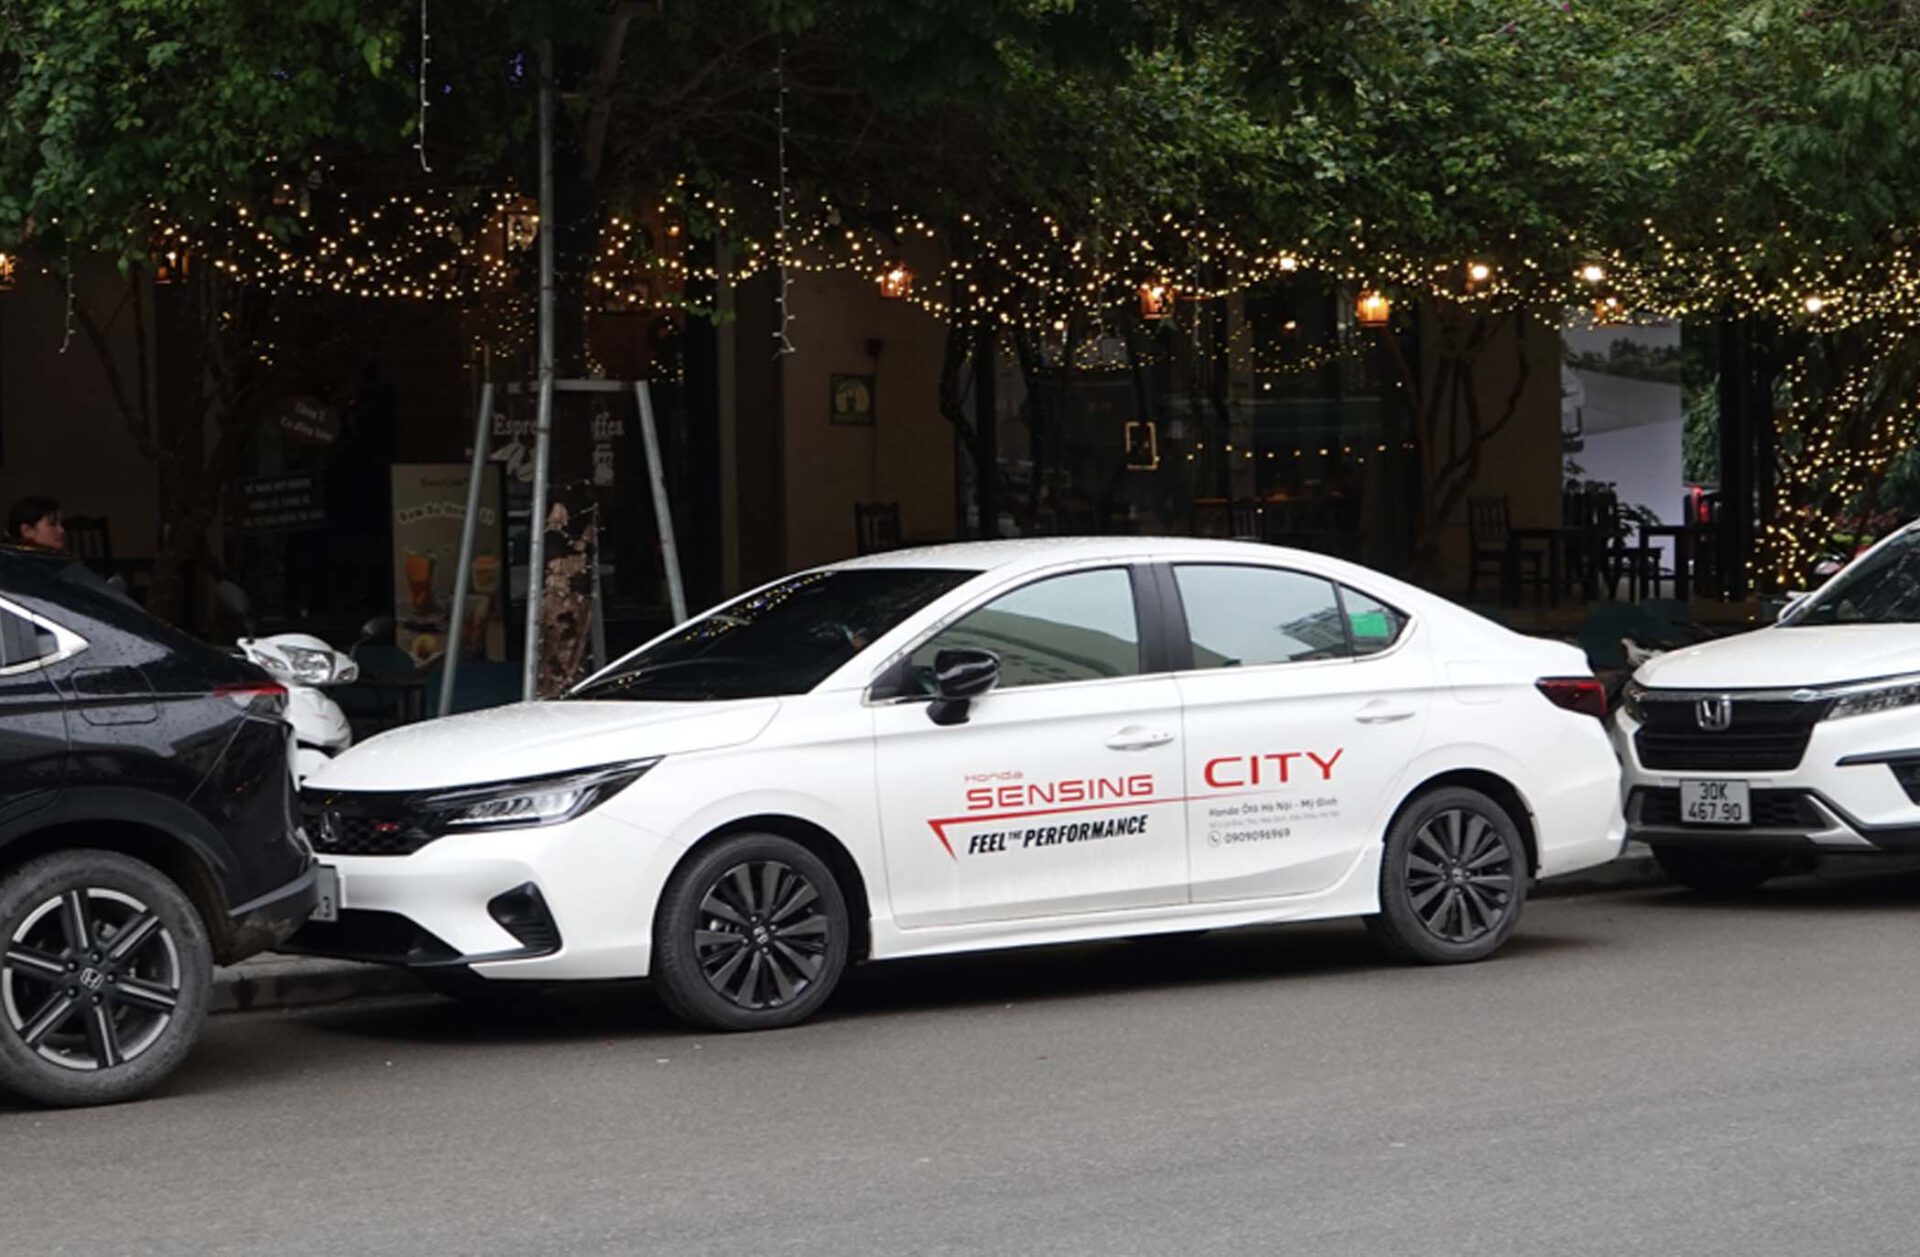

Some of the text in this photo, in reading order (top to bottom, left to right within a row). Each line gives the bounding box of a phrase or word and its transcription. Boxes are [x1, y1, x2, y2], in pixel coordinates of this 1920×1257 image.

[964, 770, 1024, 783] Honda
[1204, 748, 1345, 788] CITY
[966, 774, 1154, 811] SENSING
[1699, 782, 1728, 800] 30K
[968, 814, 1149, 855] FEEL THE PERFORMANCE
